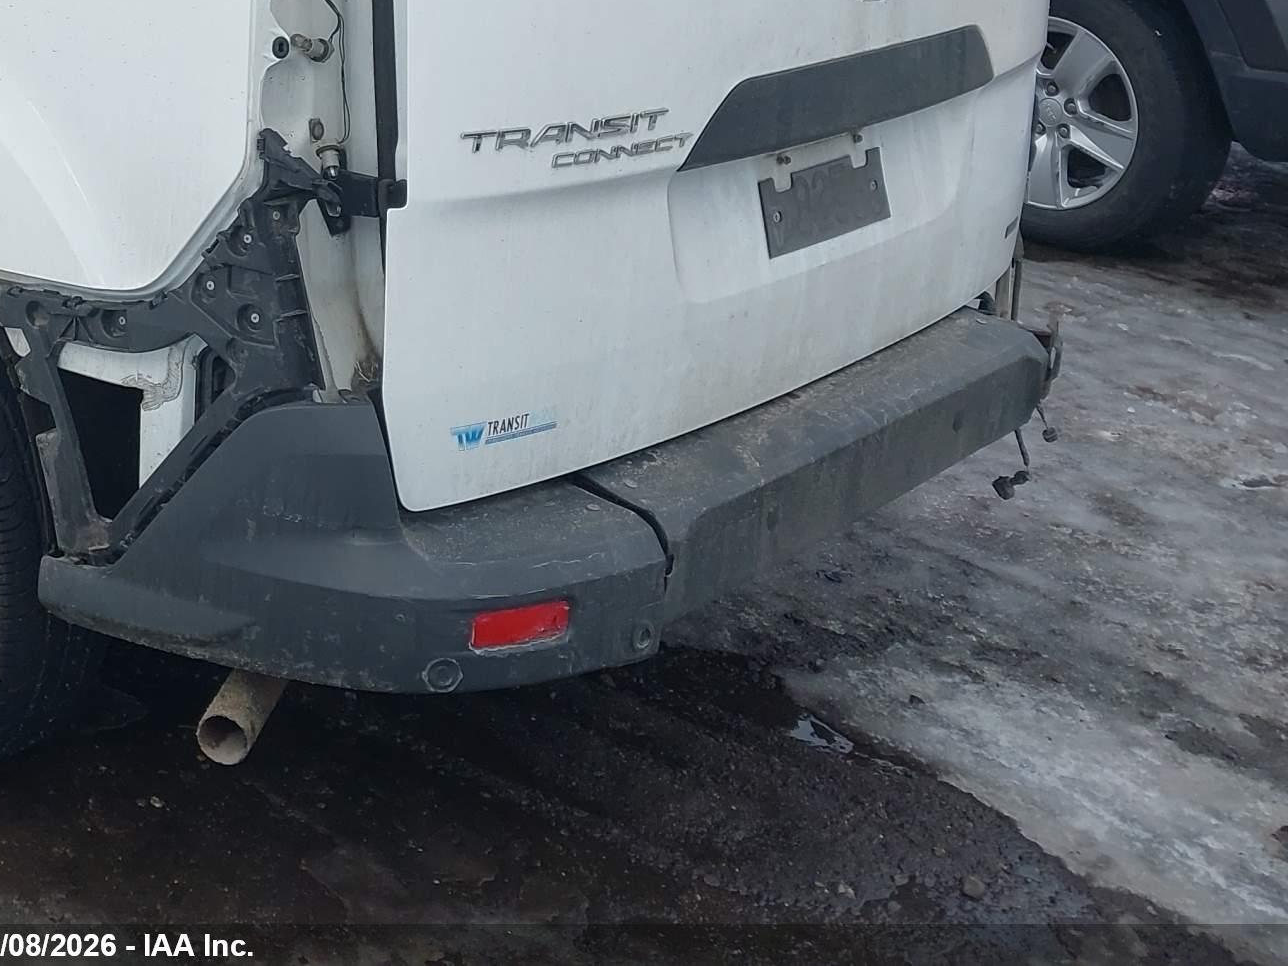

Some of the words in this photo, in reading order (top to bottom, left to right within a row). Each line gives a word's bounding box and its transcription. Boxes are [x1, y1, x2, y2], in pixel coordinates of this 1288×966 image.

[460, 107, 670, 154] TRANSIT
[551, 132, 695, 169] CONNECT
[487, 412, 530, 437] TRANSIT
